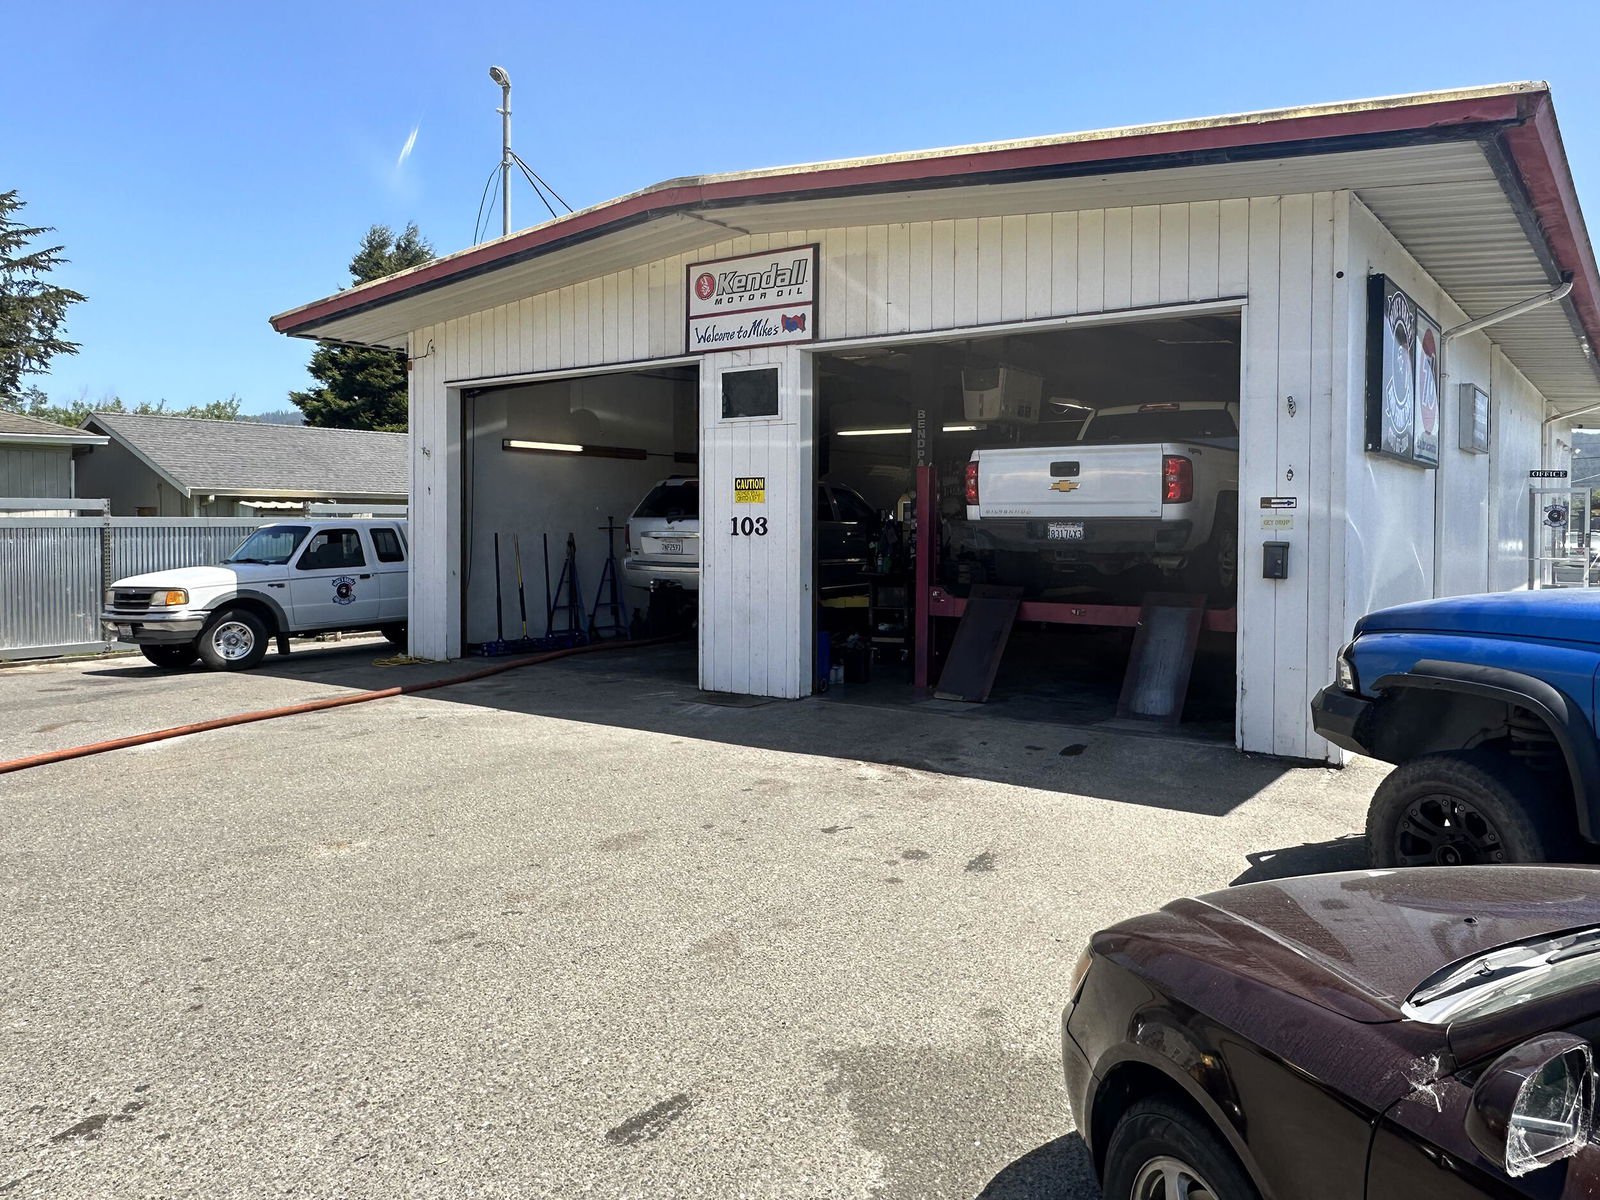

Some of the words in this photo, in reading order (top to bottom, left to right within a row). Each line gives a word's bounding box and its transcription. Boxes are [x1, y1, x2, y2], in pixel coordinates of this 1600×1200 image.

[716, 259, 807, 296] Kendall
[714, 292, 766, 305] MOTOR
[777, 287, 803, 297] OIL
[695, 325, 738, 343] Welcome
[737, 326, 747, 338] to
[747, 317, 779, 338] Mike's
[736, 479, 764, 489] CAUTION
[731, 517, 768, 536] 103
